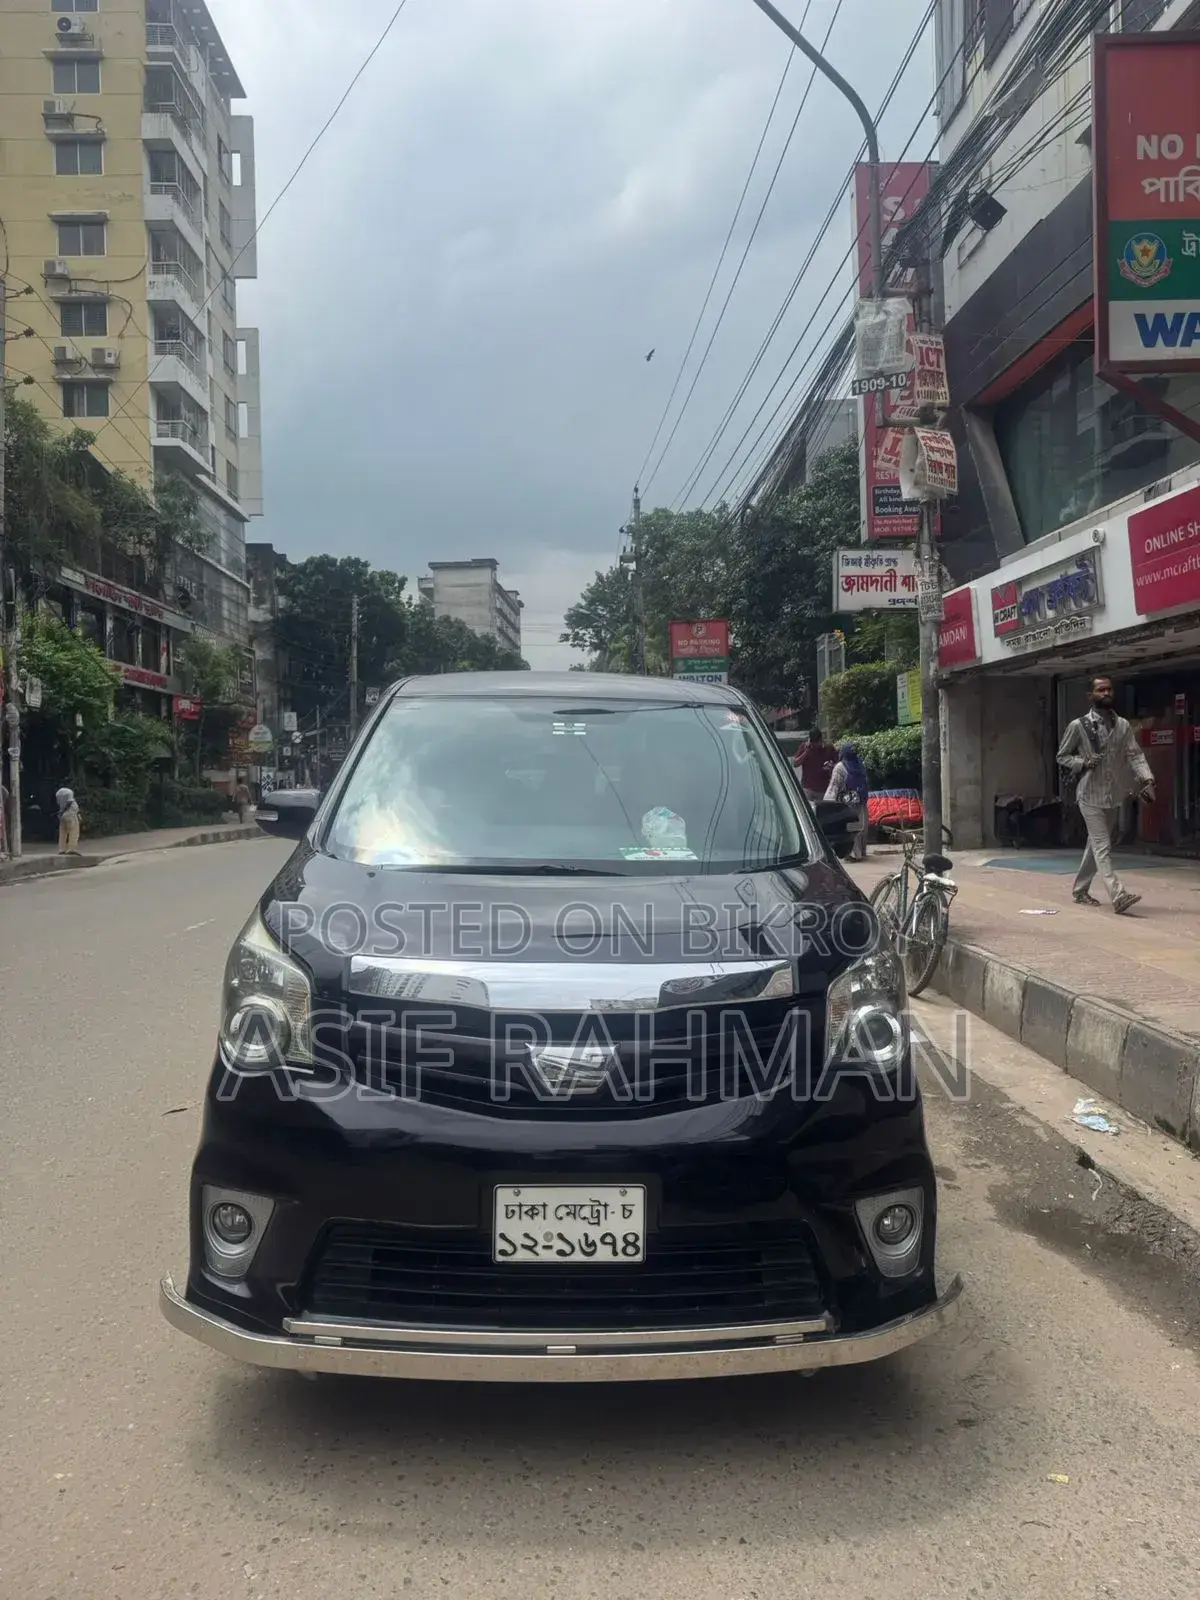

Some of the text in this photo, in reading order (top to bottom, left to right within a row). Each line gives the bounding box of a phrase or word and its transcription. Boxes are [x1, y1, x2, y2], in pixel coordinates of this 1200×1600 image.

[1136, 134, 1184, 160] NO
[918, 346, 943, 369] ICT
[874, 504, 903, 514] Booking
[1144, 525, 1186, 554] ONLINE
[840, 568, 898, 596] জামদানী
[503, 1201, 549, 1221] ঢাকা
[498, 1231, 641, 1257] ১২-১৬৭৪
